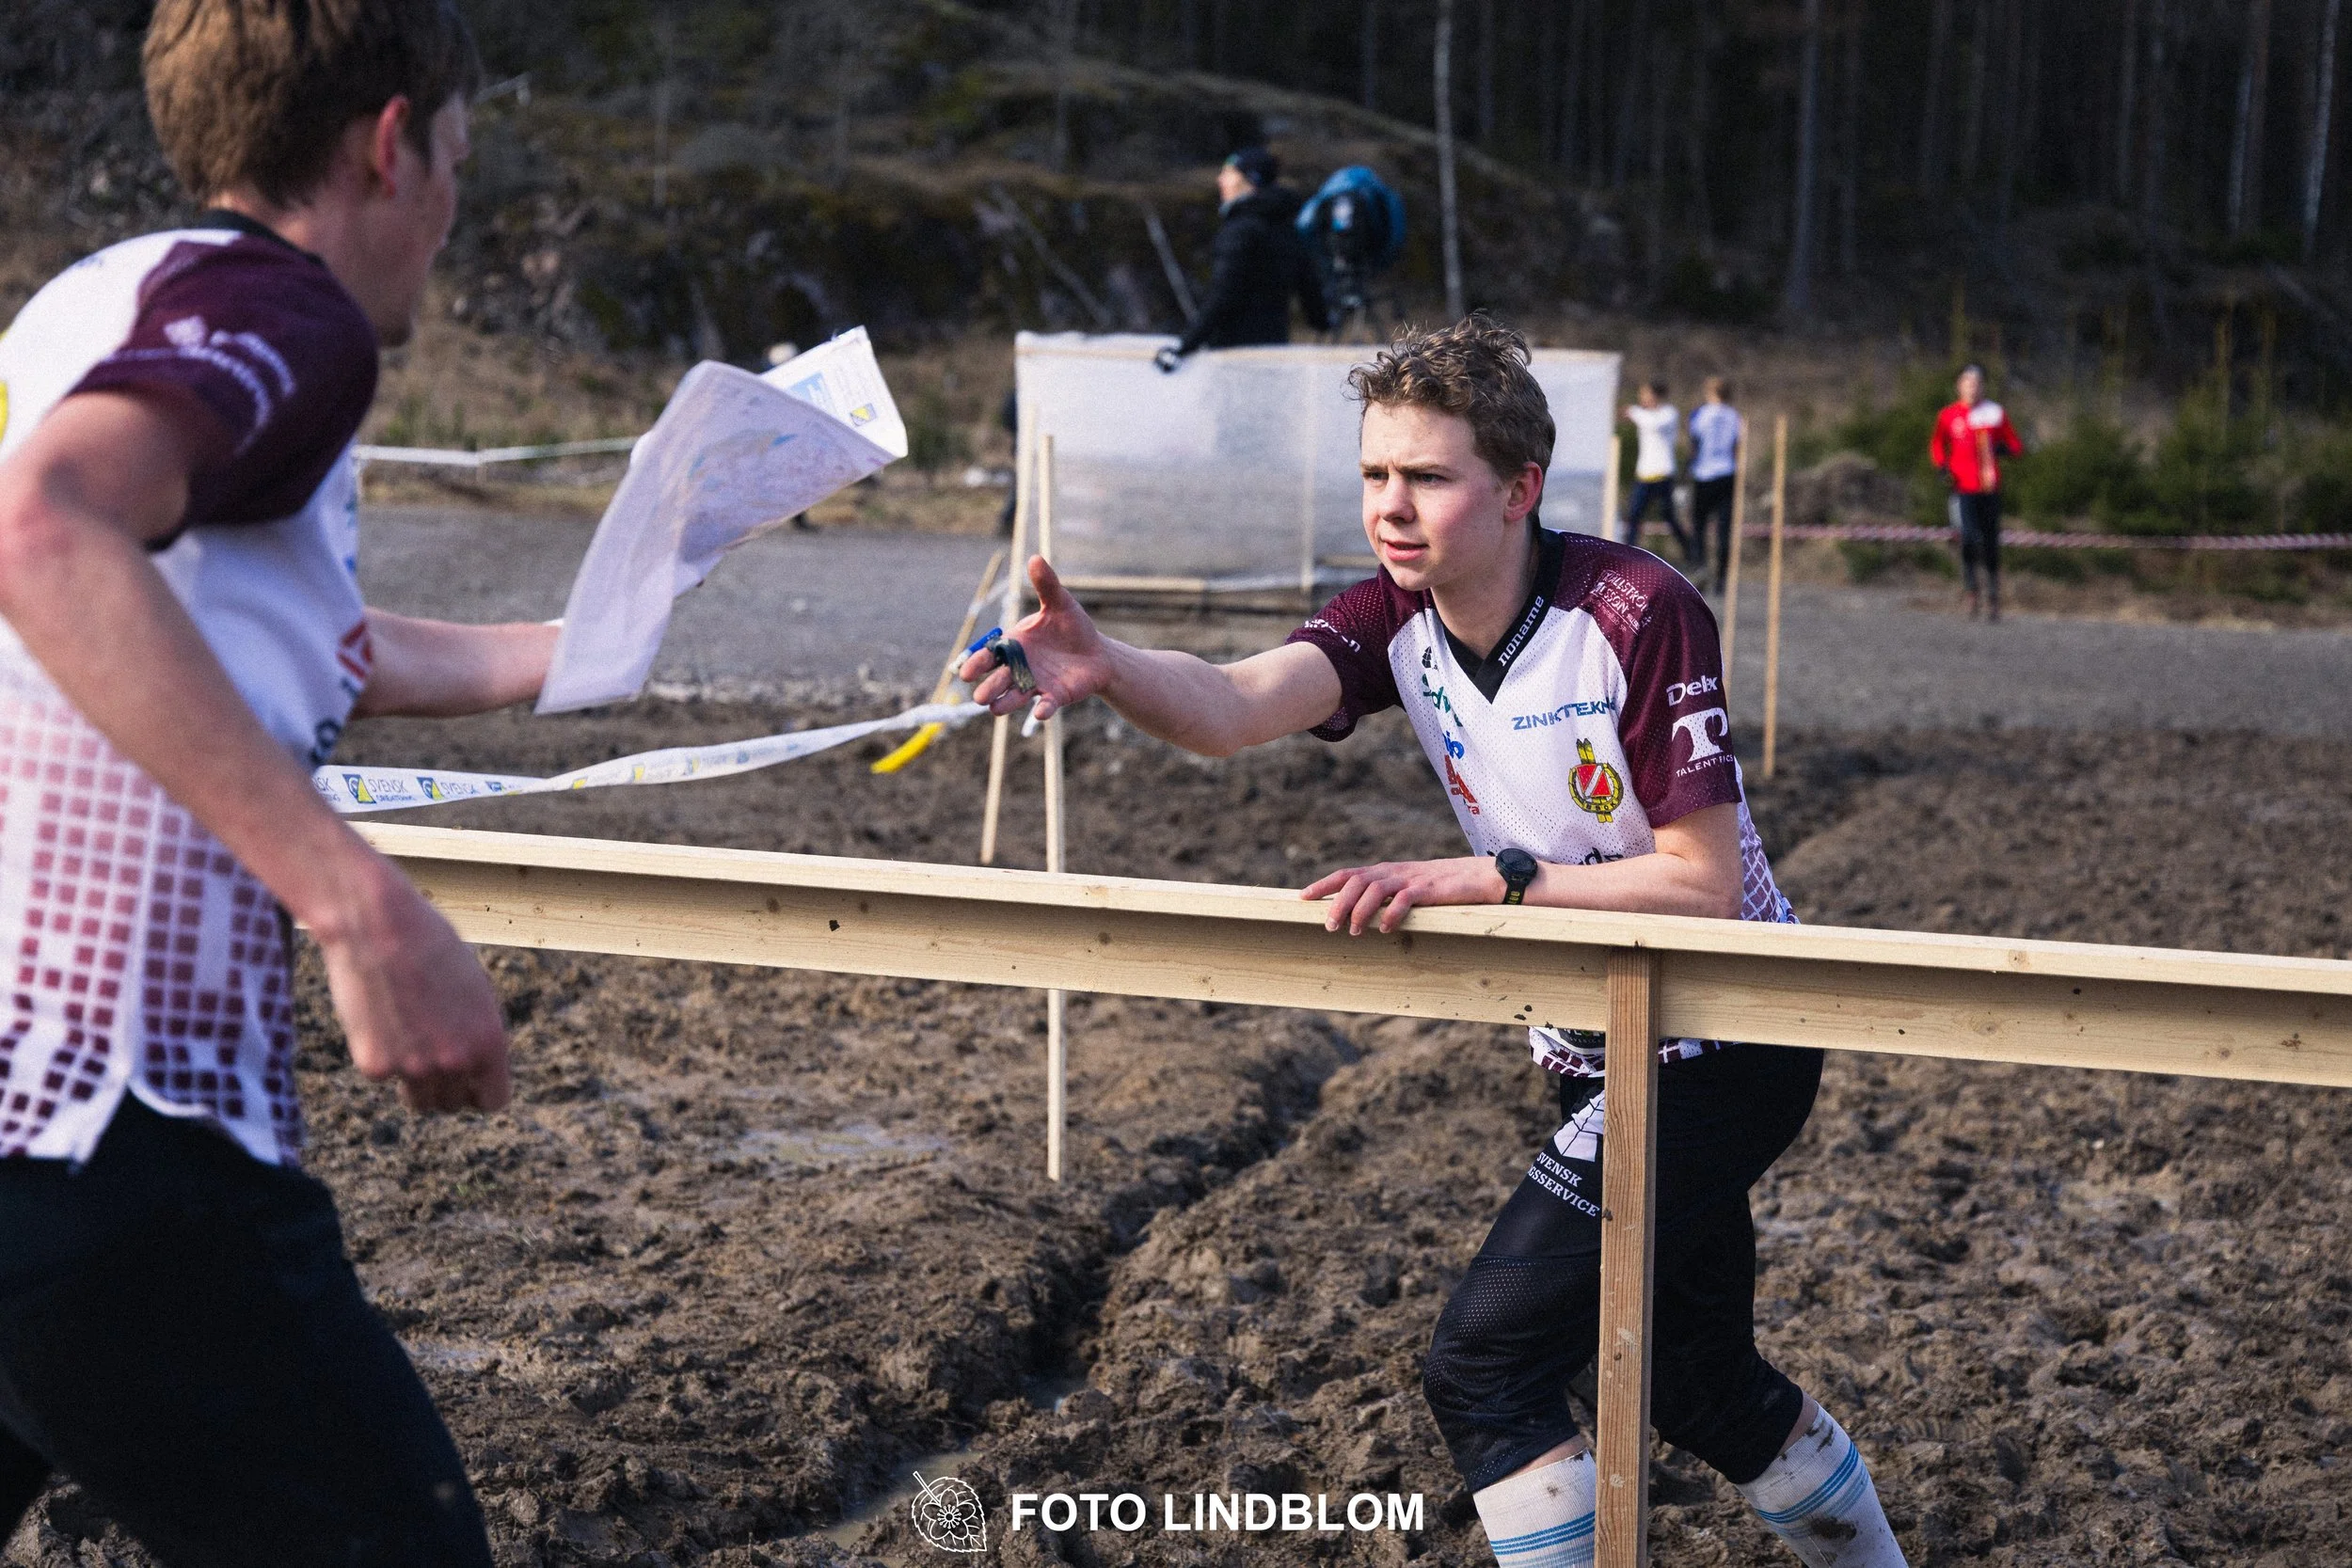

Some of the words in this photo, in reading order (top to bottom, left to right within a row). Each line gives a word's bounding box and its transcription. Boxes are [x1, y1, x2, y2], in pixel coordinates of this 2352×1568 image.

[1498, 595, 1544, 667] noname
[1512, 698, 1615, 730] ZINKTEKN
[1676, 757, 1717, 778] TALENT
[1536, 1151, 1582, 1187] SVENSK
[1528, 1164, 1600, 1217] GSSERVICE
